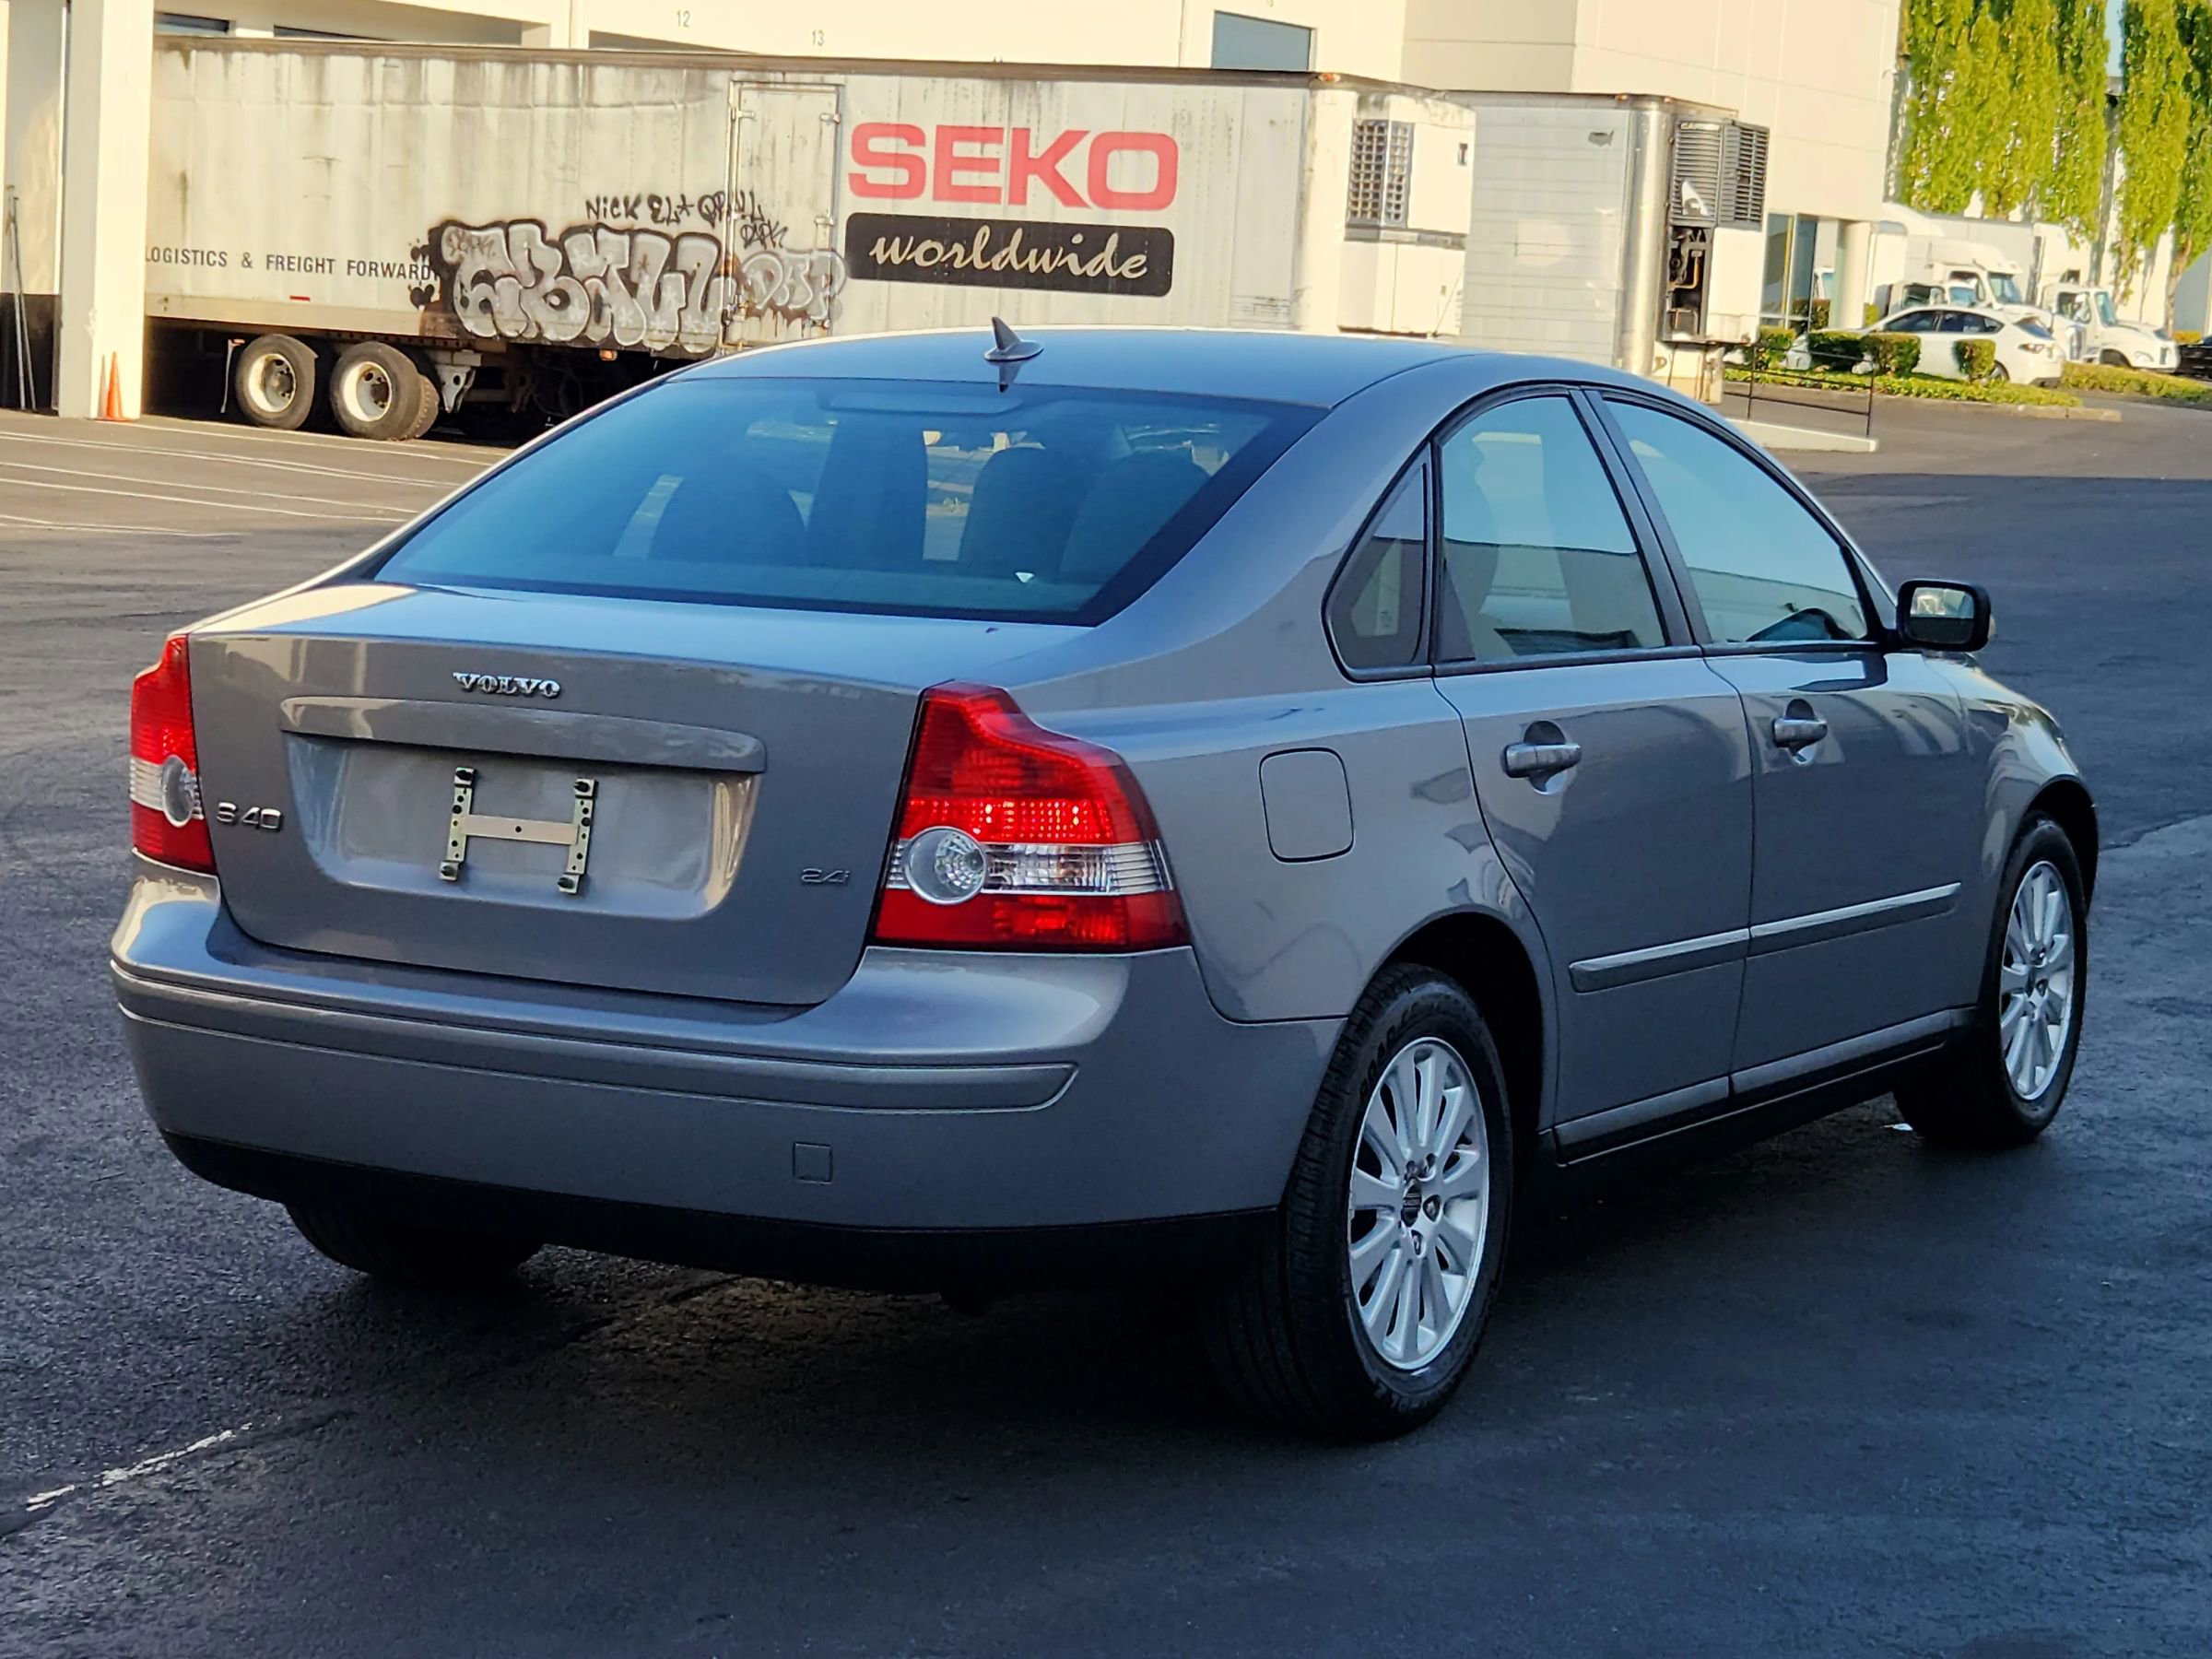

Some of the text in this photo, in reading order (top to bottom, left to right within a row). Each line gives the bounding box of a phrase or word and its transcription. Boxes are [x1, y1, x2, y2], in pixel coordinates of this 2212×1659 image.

[677, 10, 690, 28] 12
[812, 29, 825, 47] 13
[848, 122, 1179, 211] SEKO
[145, 246, 229, 267] LOGISTICS
[241, 253, 253, 268] &
[266, 254, 335, 275] FREIGHT
[868, 224, 1149, 279] worldwide
[452, 672, 560, 698] VOLVO
